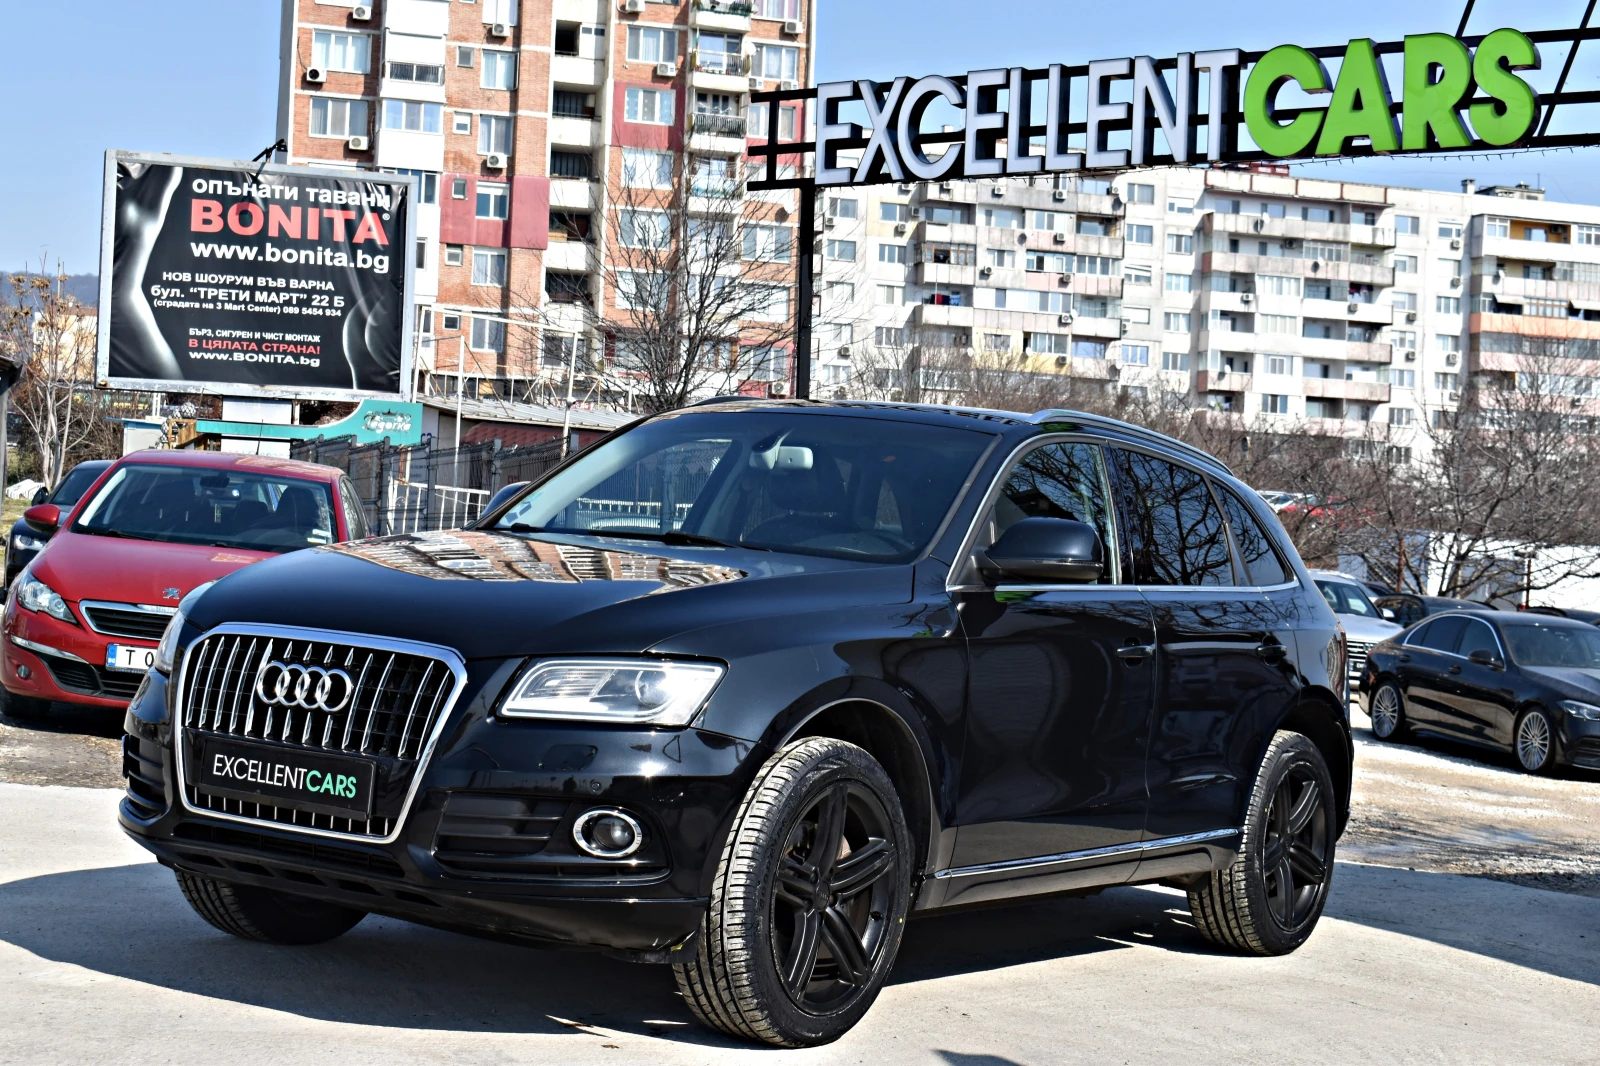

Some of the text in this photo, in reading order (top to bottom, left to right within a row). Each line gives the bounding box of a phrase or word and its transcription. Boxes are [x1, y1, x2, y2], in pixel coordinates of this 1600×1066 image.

[192, 178, 391, 209] опънати тавани
[190, 242, 389, 274] www.bonita.bg
[163, 271, 335, 291] НОВ ШОУРУМ ВЪВ ВАРНА
[150, 285, 185, 299] бул.
[311, 295, 330, 306] 22
[334, 296, 345, 307] Б
[153, 298, 342, 317] (сградата на 3 Mart Center) 089 5454 934
[189, 328, 321, 343] БЪРЗ, СИГУРЕН И ЧИСТ МОНТАЖ
[188, 339, 321, 354] В ЦЯЛАТА СТРАНА!
[189, 351, 321, 367] www.BONITA.bg
[125, 649, 136, 666] T
